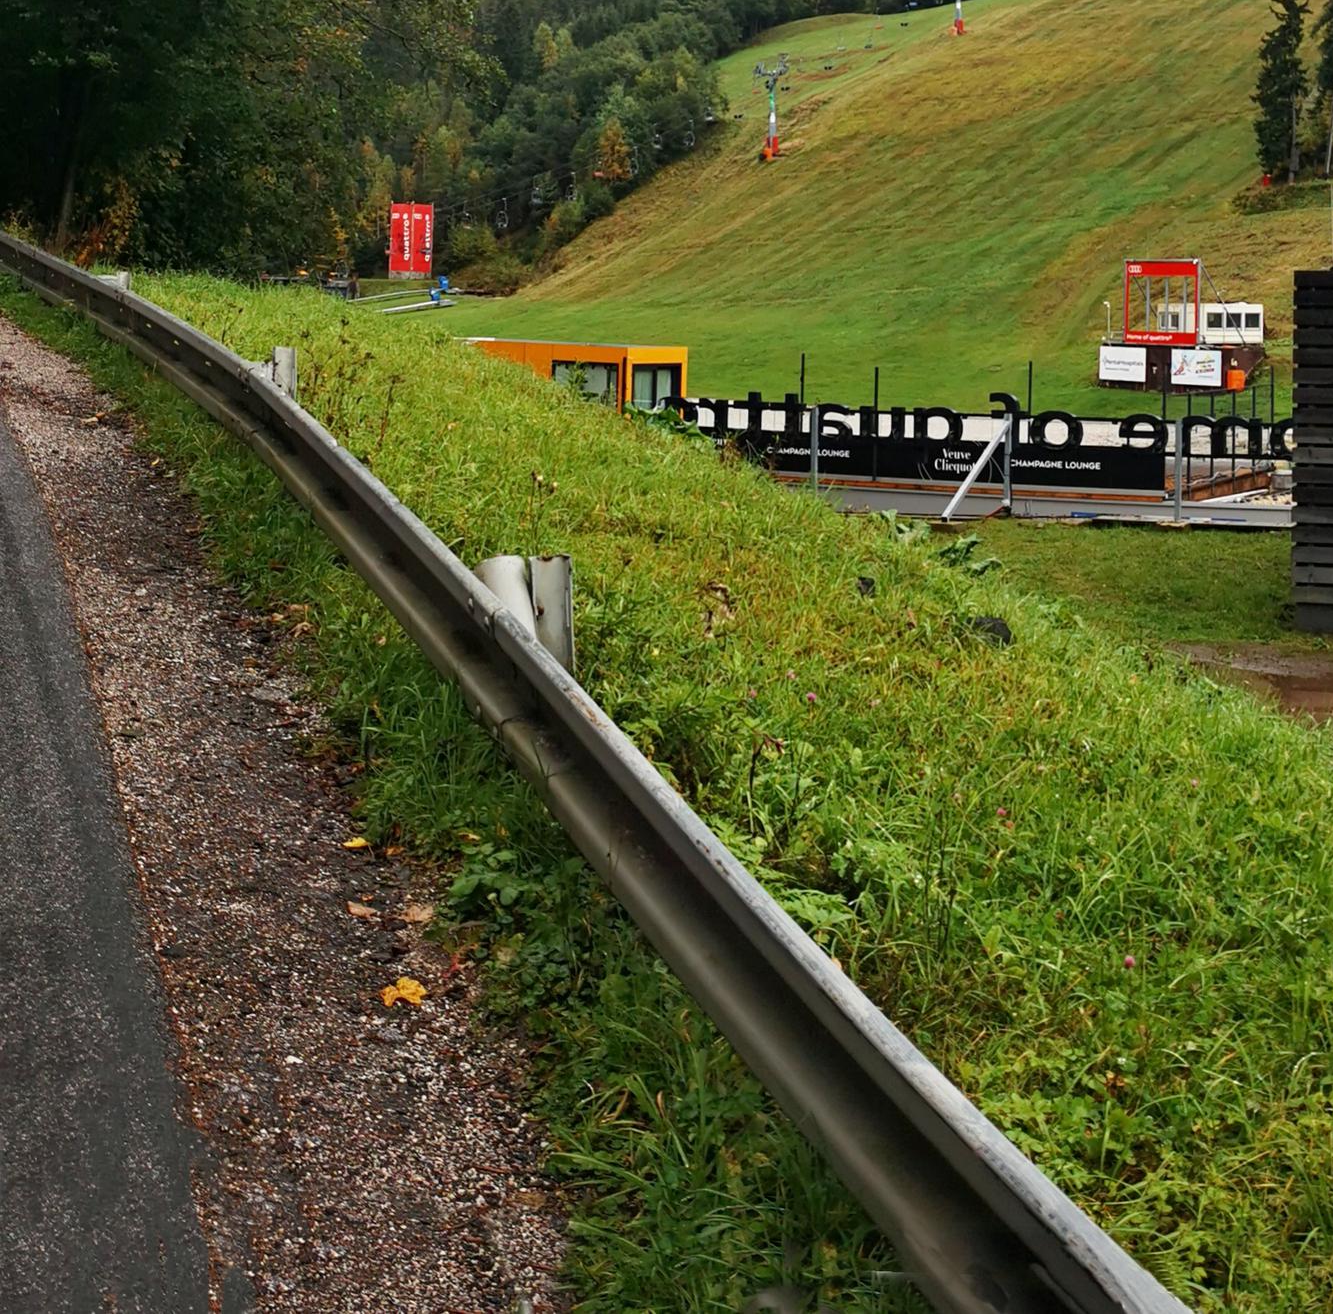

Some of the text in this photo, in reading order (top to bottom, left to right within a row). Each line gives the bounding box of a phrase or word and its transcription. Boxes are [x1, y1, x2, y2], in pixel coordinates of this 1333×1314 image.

[766, 446, 850, 458] CAMPAGN LOUNGE
[942, 447, 971, 460] Veuve
[1065, 461, 1101, 470] LOUNGE
